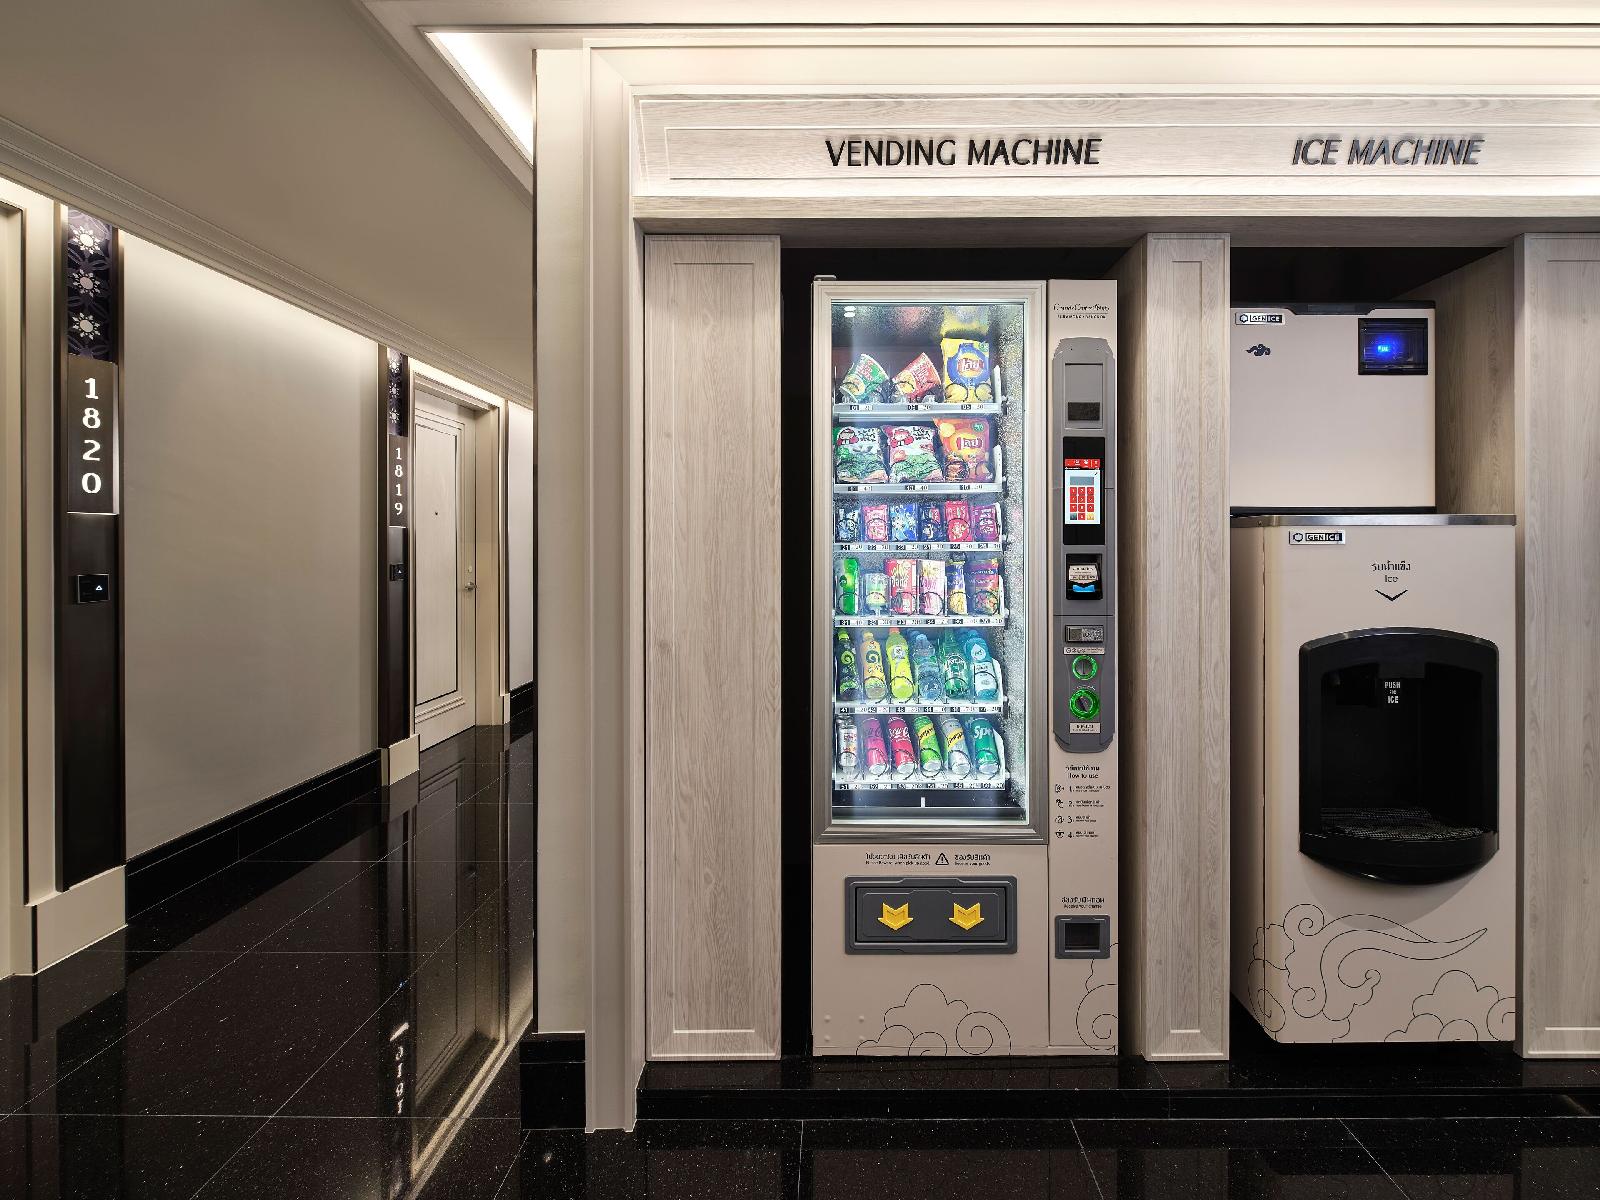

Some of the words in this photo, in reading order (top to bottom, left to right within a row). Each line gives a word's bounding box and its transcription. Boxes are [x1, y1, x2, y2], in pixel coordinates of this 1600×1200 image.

[825, 138, 956, 166] VENDING
[967, 138, 1102, 166] MACHINE
[1292, 138, 1342, 165] ICE
[1347, 138, 1485, 165] MACHINE
[81, 377, 102, 494] 1820
[394, 447, 403, 515] 1819
